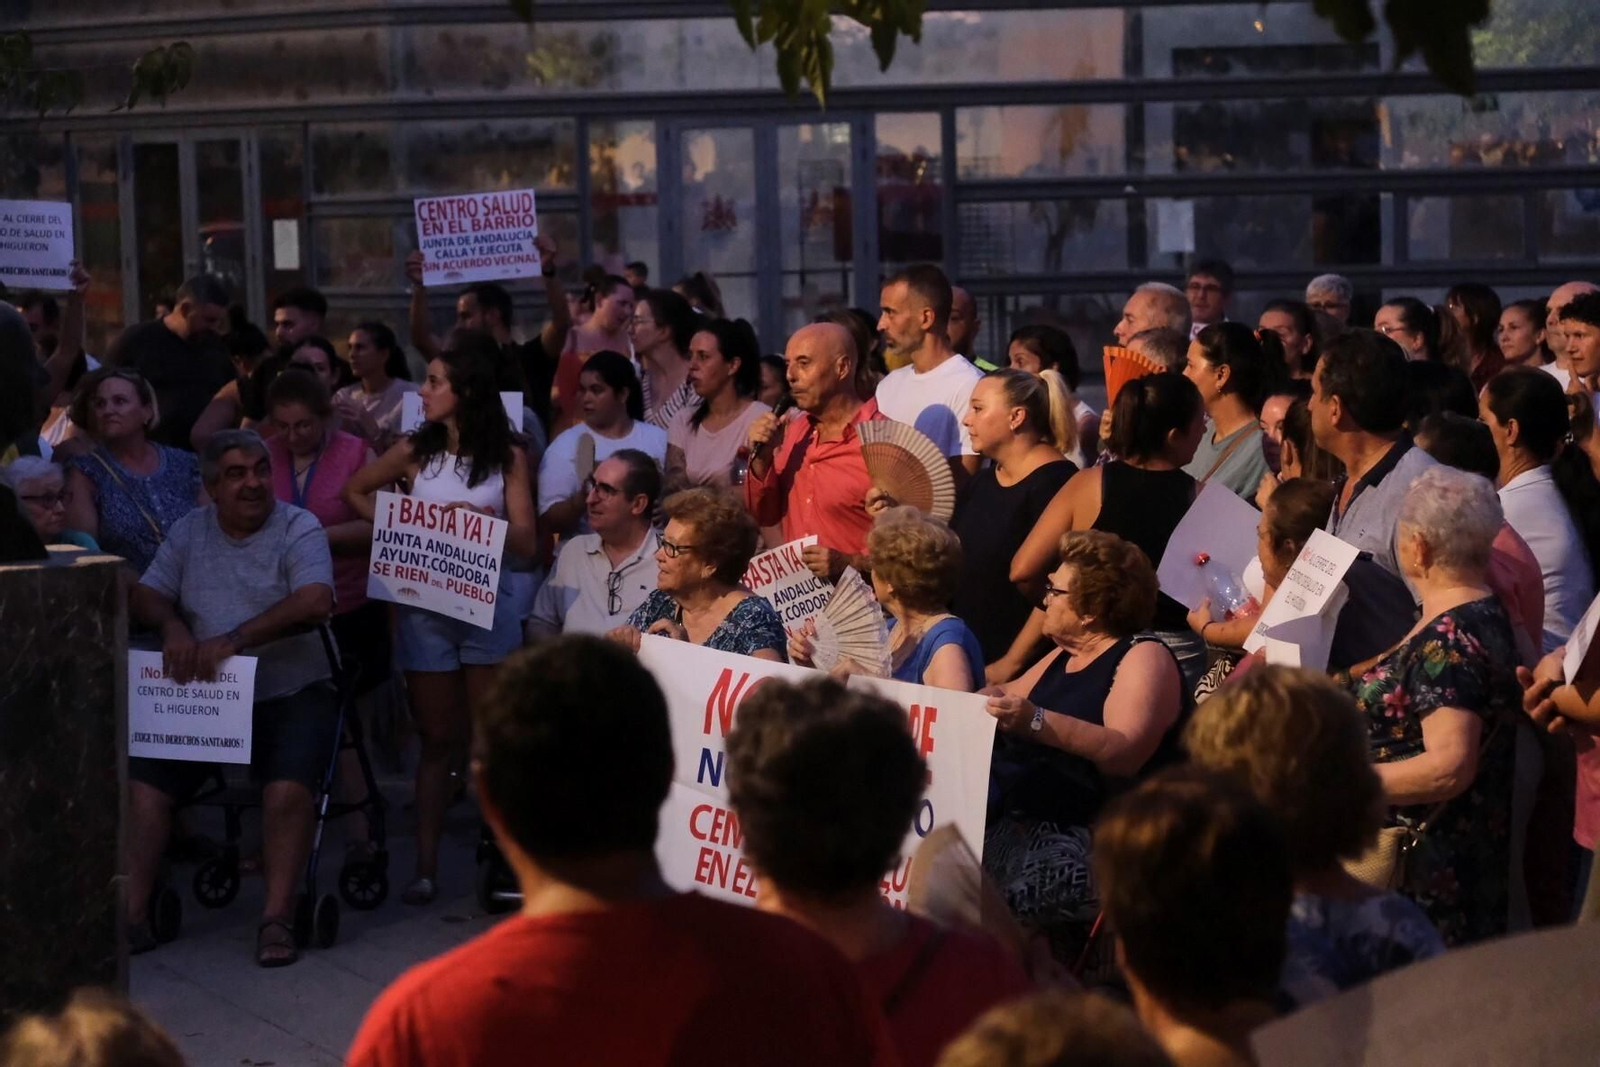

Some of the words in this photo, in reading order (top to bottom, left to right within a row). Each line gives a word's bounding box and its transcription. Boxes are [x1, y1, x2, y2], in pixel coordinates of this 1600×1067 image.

[418, 197, 478, 222] CENTRO
[482, 192, 532, 217] SALUD
[17, 215, 45, 224] CIERRE
[48, 215, 62, 224] DEL
[422, 221, 444, 236] EN
[448, 219, 468, 234] EL
[471, 213, 534, 232] BARRIO
[10, 228, 21, 237] DE
[24, 230, 52, 238] SALUD
[54, 230, 65, 238] EN
[422, 237, 455, 249] JUNTA
[456, 236, 471, 246] DE
[473, 230, 534, 244] ANDALUCÍA
[435, 247, 468, 260] CALLA
[470, 246, 477, 256] Y
[480, 243, 523, 256] EJECUTA
[423, 262, 440, 272] SIN
[443, 257, 492, 271] ACUERDO
[494, 253, 538, 266] VECINAL
[375, 529, 421, 549] JUNTA
[425, 539, 497, 572] ANDALUCÍA
[372, 561, 391, 577] SE
[394, 566, 429, 584] RIEN
[431, 580, 443, 589] DEL
[446, 578, 495, 605] PUEBLO
[220, 671, 239, 683] DEL
[137, 685, 174, 697] CENTRO
[176, 687, 189, 698] DE
[192, 688, 224, 700] SALUD
[226, 690, 240, 700] EN
[154, 703, 165, 714] EL
[167, 704, 220, 716] HIGUERON
[152, 733, 164, 745] TUS
[165, 734, 200, 746] DERECHOS
[695, 847, 731, 889] EN
